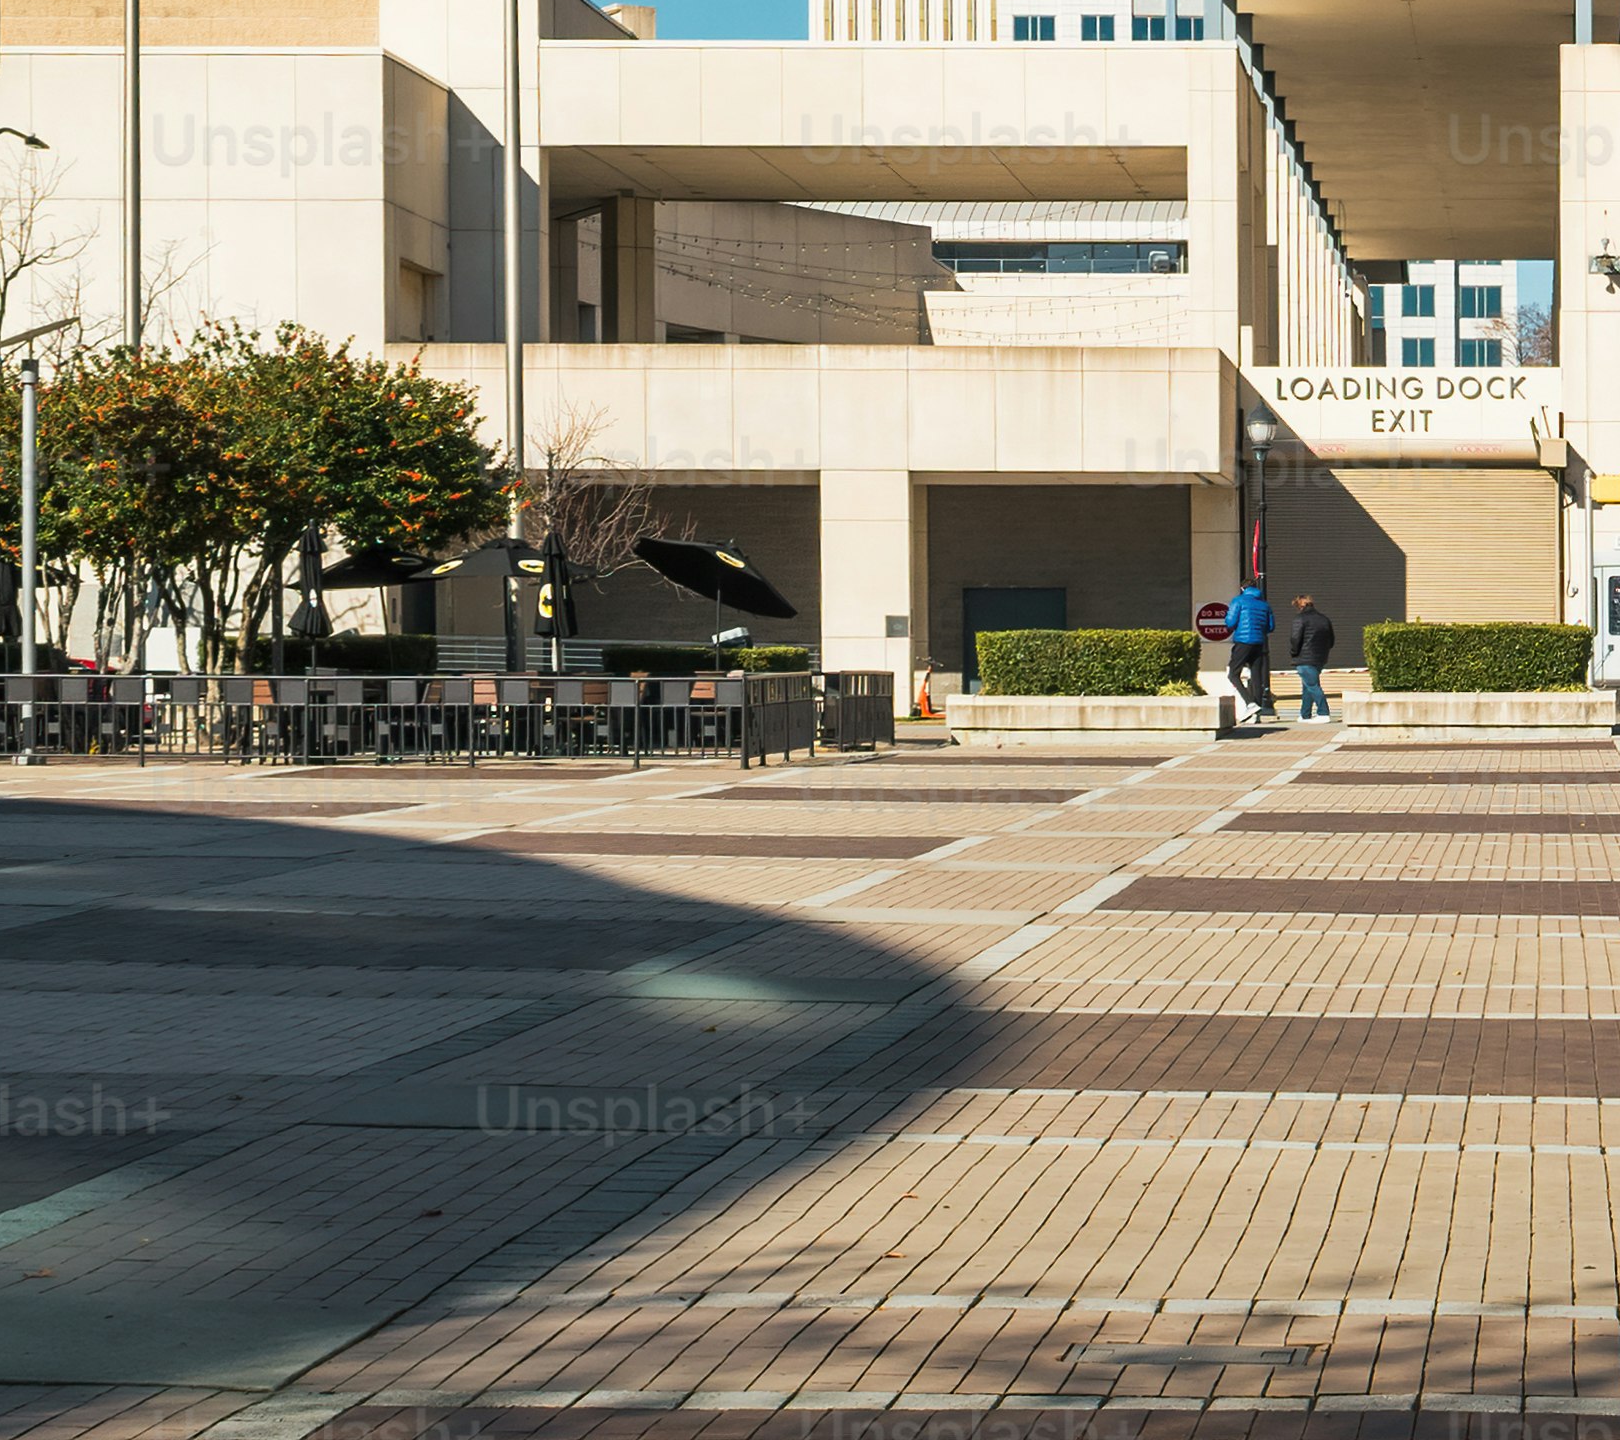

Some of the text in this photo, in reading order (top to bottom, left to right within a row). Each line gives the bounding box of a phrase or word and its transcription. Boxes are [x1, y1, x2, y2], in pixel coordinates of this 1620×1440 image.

[1276, 375, 1527, 401] LOADING DOCK
[1371, 409, 1433, 433] EXIT
